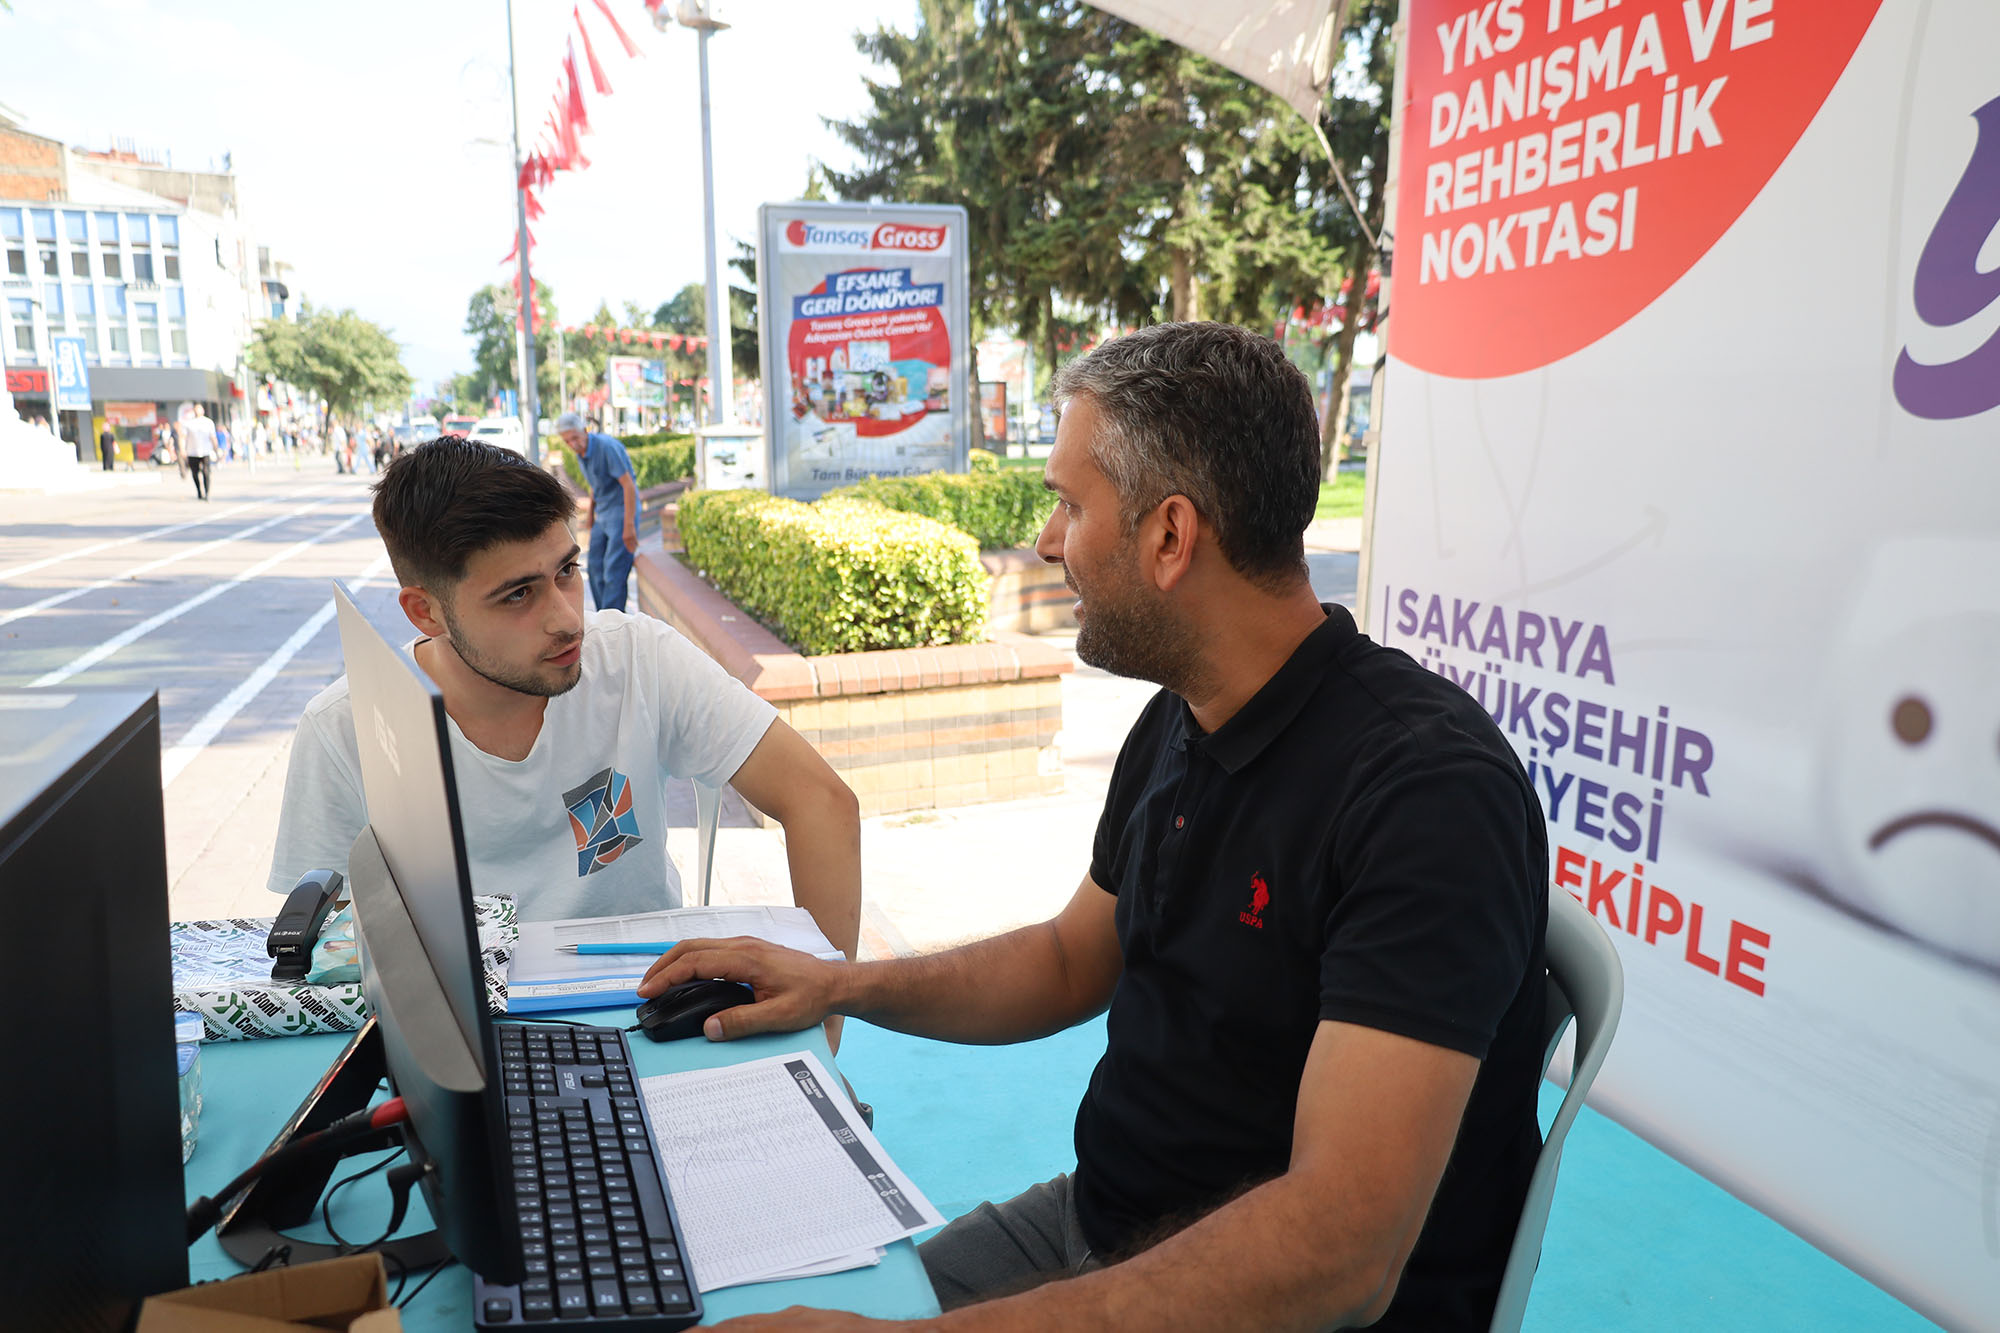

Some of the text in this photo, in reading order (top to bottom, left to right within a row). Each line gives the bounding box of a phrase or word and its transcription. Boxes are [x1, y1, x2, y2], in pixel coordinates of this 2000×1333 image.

[1437, 0, 1524, 75] YKS
[1429, 0, 1775, 148] DANIŞMA VE
[1424, 75, 1729, 217] REHBERLİK
[803, 225, 939, 249] Tansaş Gross
[1419, 186, 1638, 285] NOKTASI
[835, 271, 904, 292] EFSANE
[801, 287, 938, 316] GERİ DÖNÜYOR!
[811, 467, 841, 481] Tam
[1395, 588, 1615, 686] SAKARYA
[1239, 911, 1264, 929] USPA
[1554, 845, 1771, 998] EKİPLE
[294, 989, 329, 1018] Copier
[247, 1010, 264, 1027] Office
